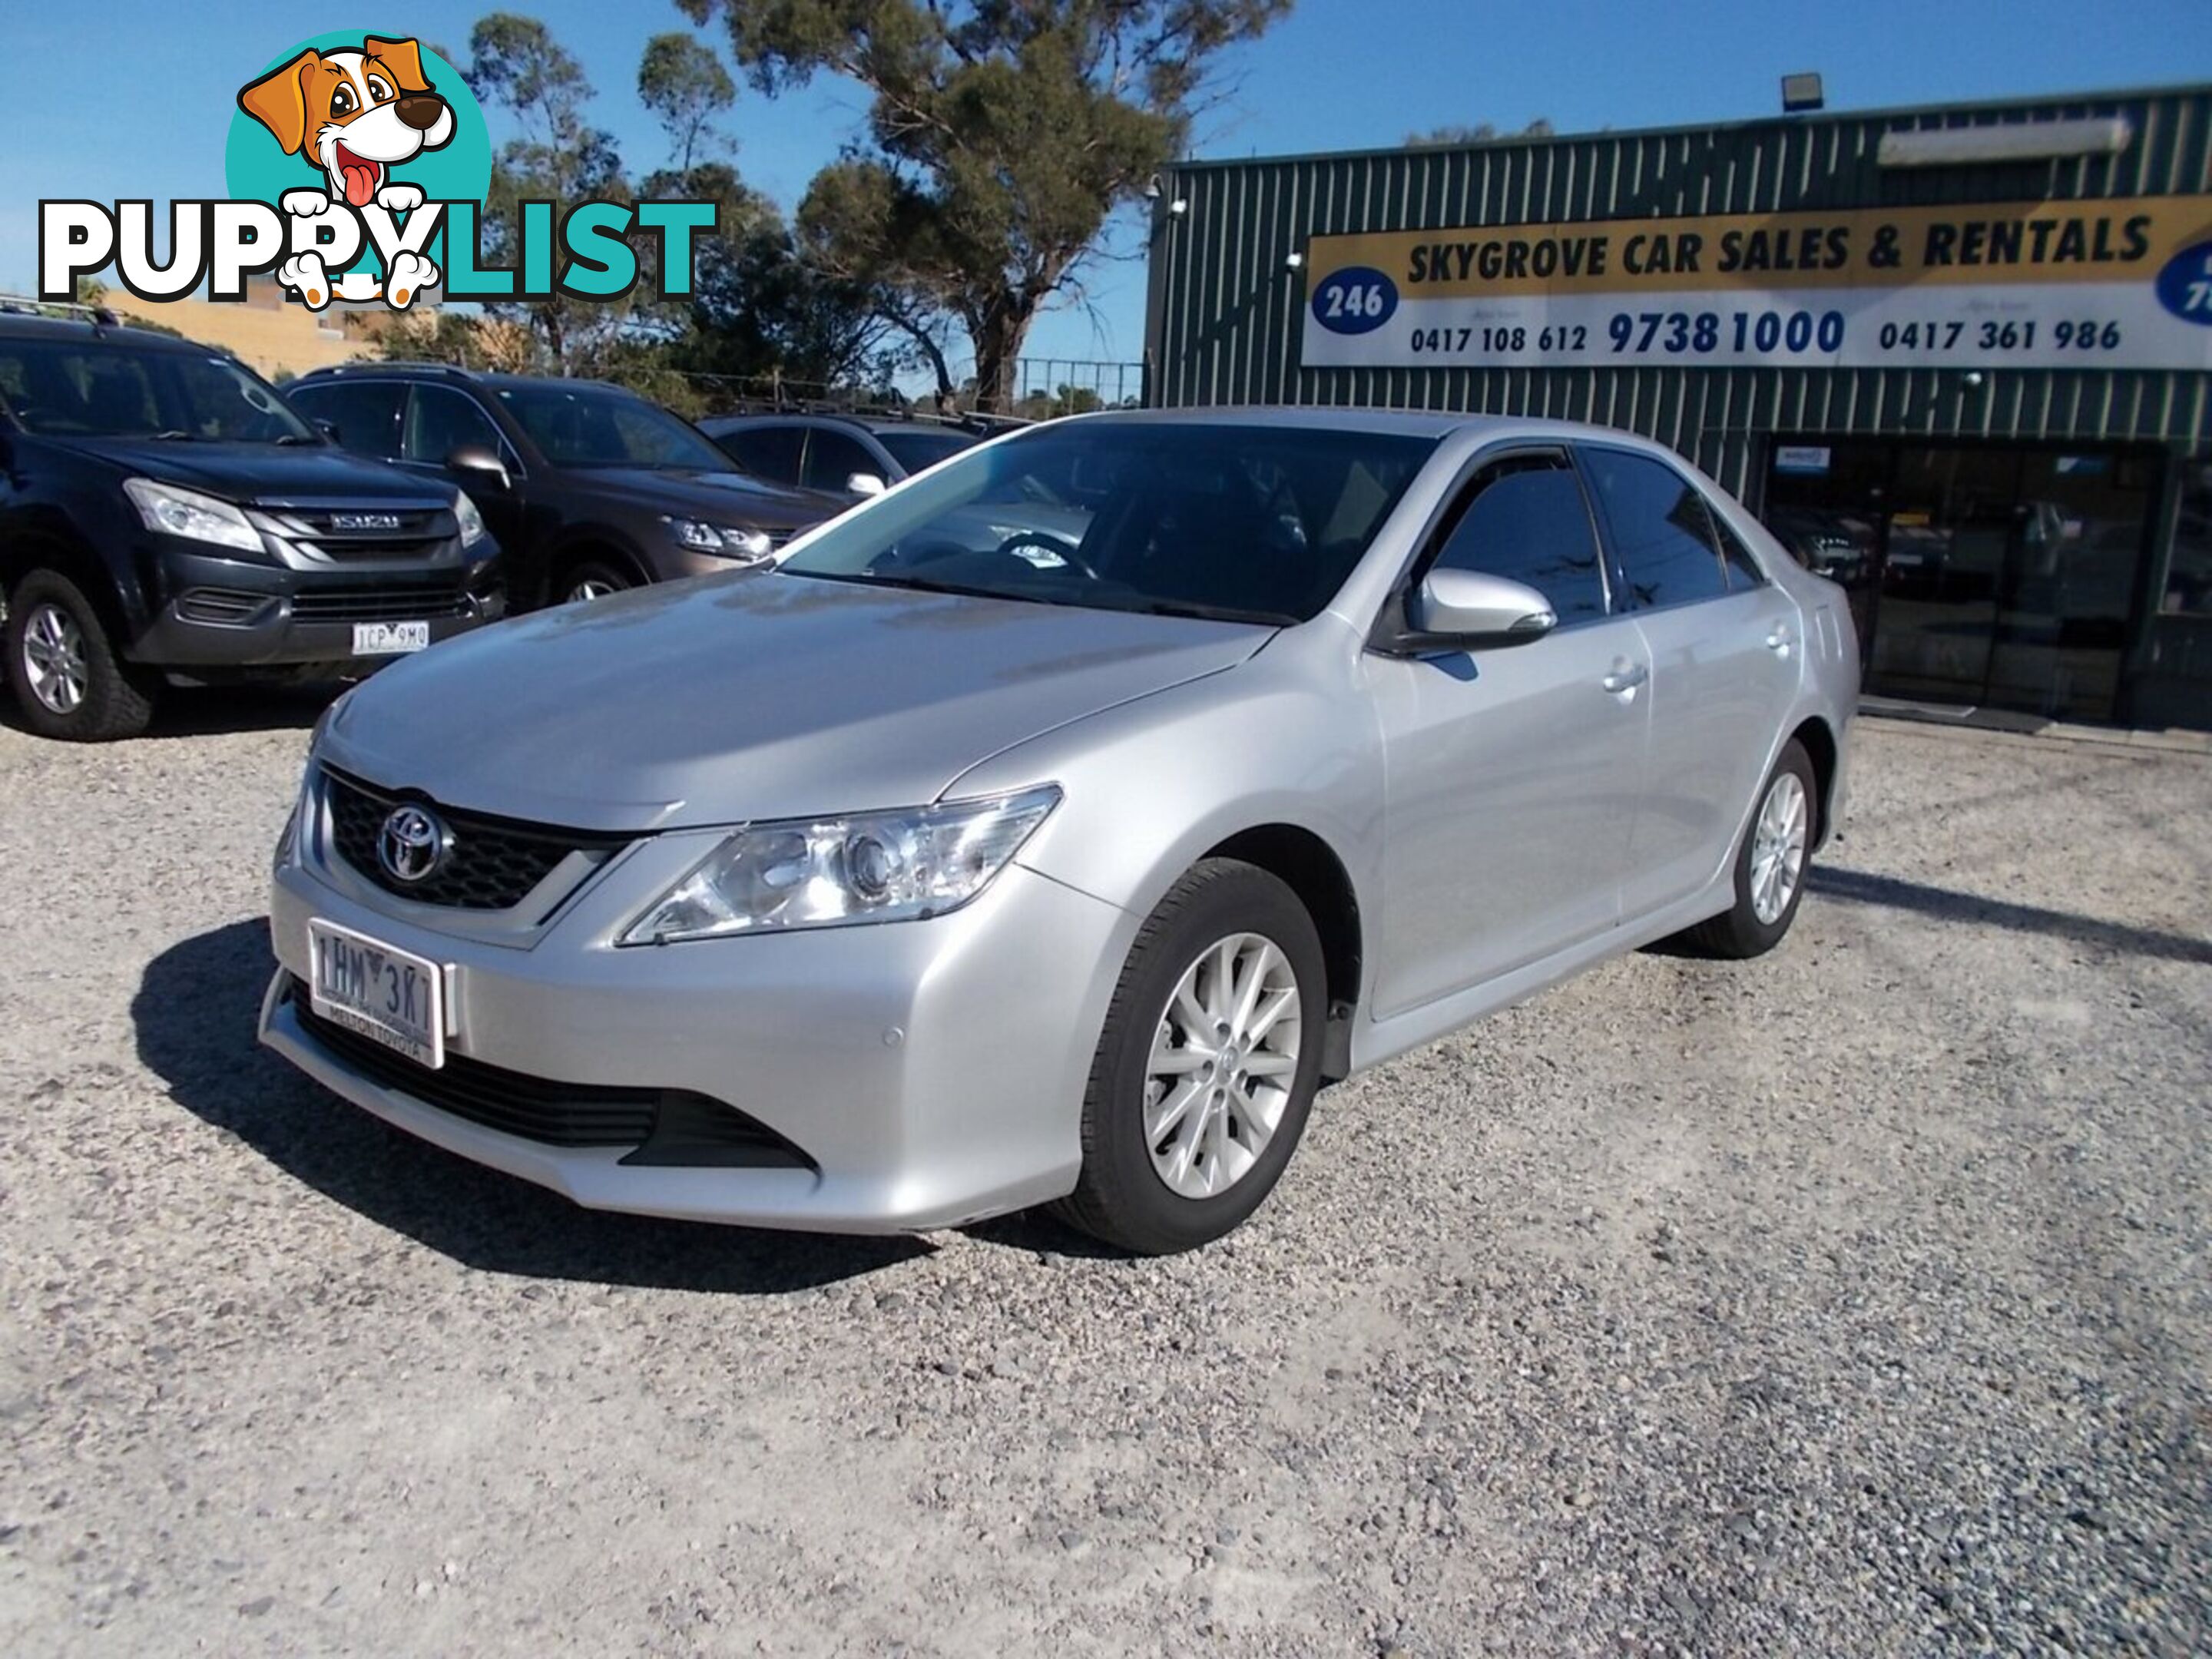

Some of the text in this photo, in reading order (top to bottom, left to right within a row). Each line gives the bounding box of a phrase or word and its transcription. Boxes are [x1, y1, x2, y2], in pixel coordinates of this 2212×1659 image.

[1408, 237, 1608, 283] SKYGROVE
[1623, 233, 1703, 275] CAR
[1717, 227, 1849, 271] SALES
[1868, 224, 1902, 268] &
[1922, 215, 2151, 267] RENTALS
[1326, 285, 1382, 317] 246
[1411, 326, 1587, 353] 0417 108 612
[1879, 320, 2121, 350] 0417 361 986
[333, 515, 399, 529] ISUZU
